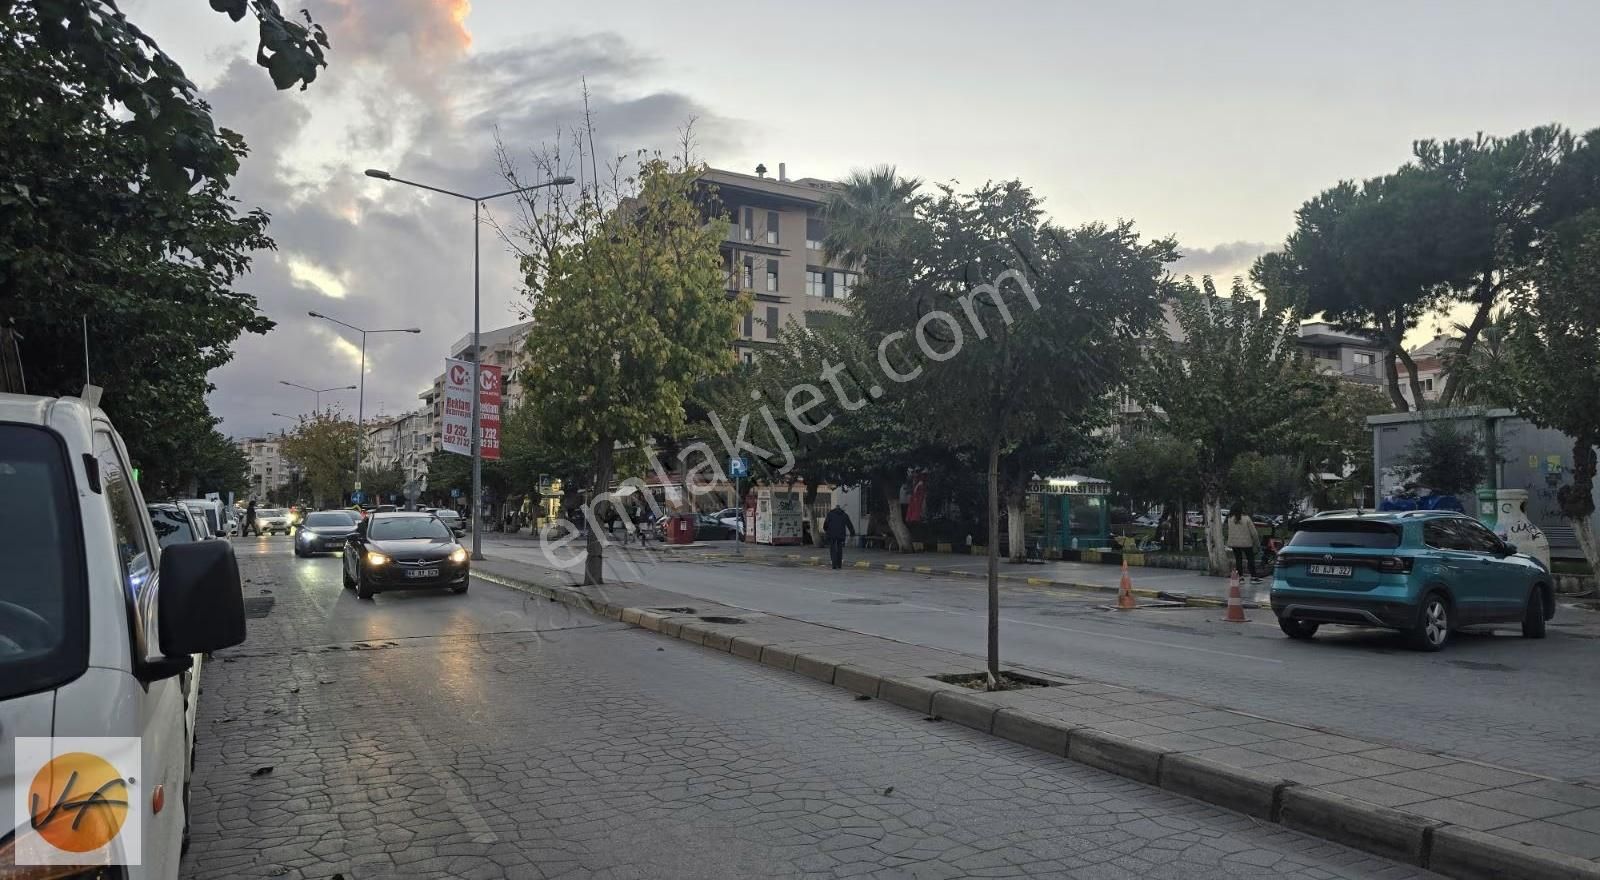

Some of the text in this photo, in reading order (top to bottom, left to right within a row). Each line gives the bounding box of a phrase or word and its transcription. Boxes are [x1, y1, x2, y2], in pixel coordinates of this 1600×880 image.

[446, 397, 471, 412] Reklam
[454, 424, 468, 437] 232
[731, 460, 741, 474] P
